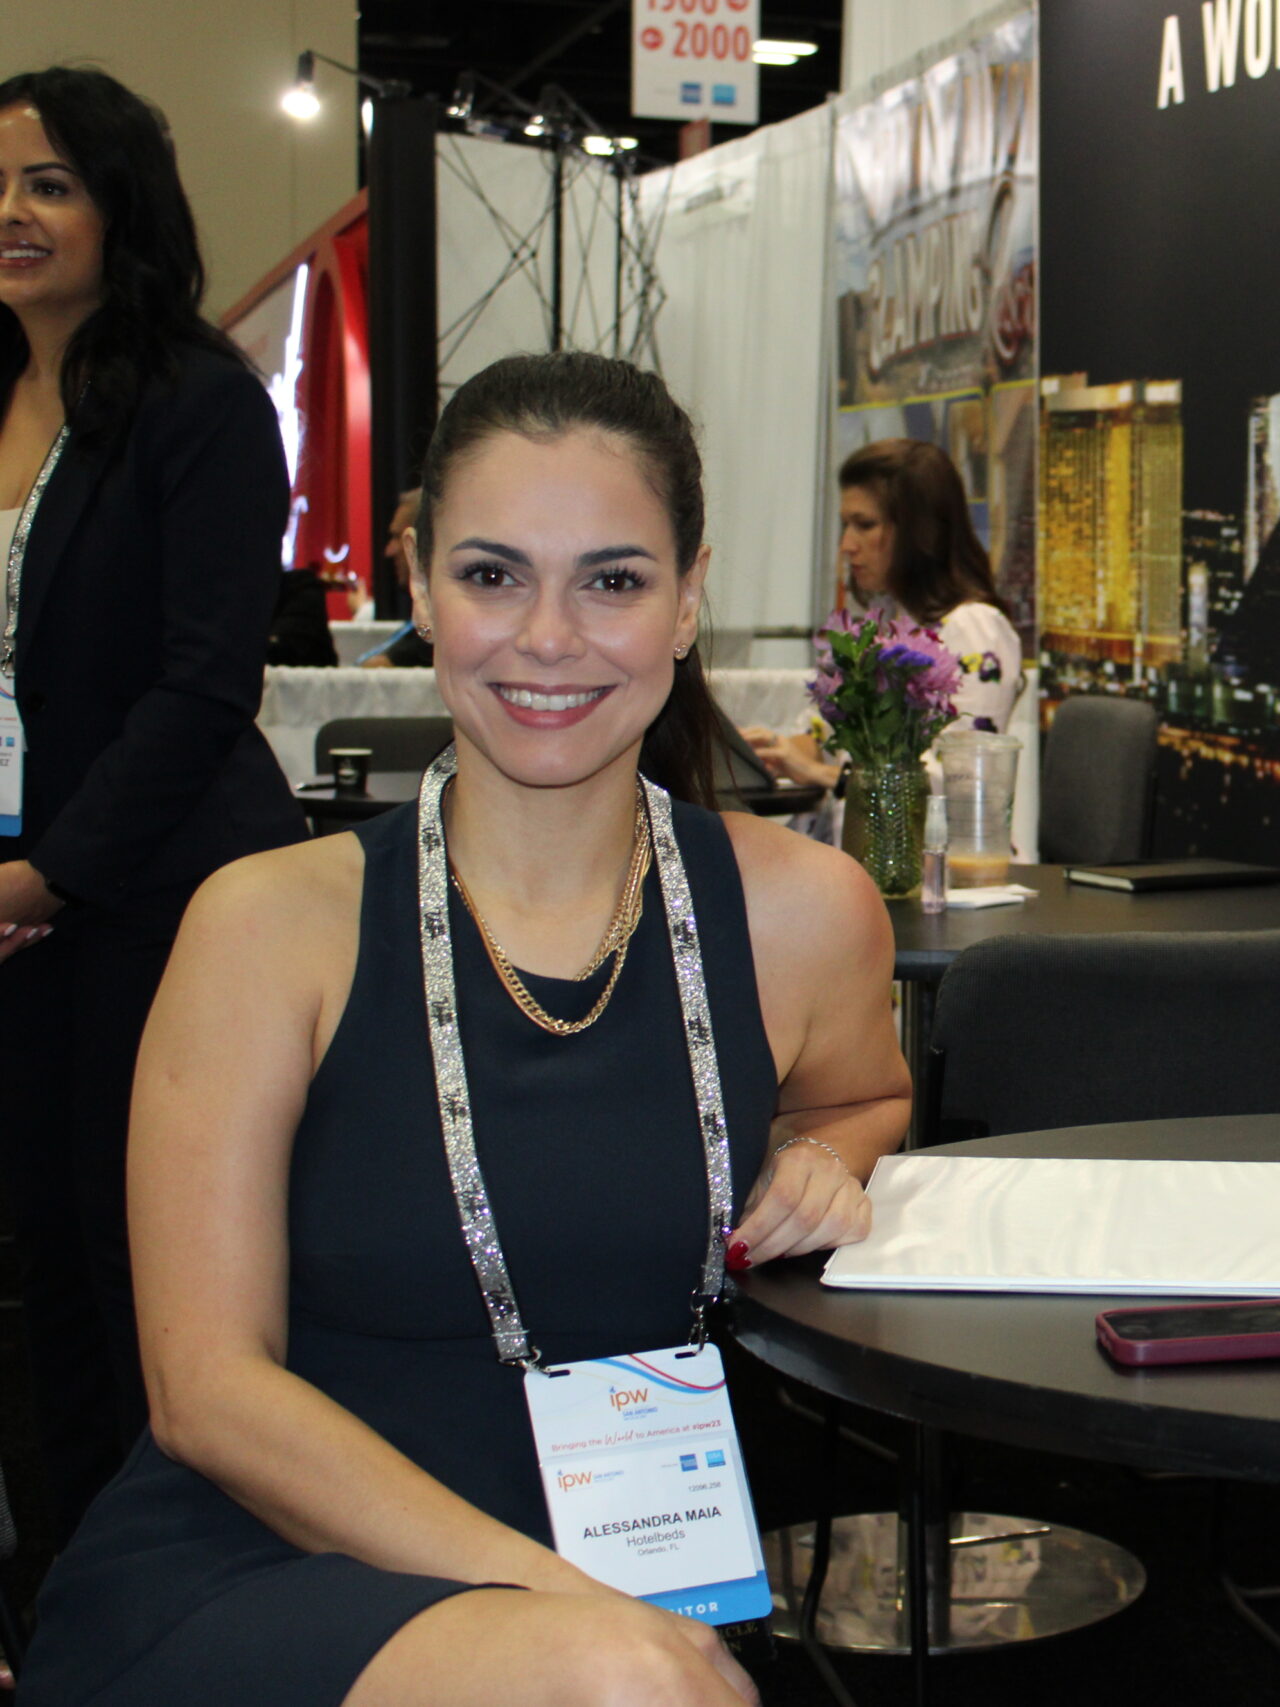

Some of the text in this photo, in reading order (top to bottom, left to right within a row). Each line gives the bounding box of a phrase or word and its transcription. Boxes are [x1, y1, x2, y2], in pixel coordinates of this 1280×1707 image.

[672, 19, 751, 62] 2000
[1157, 15, 1185, 109] A
[609, 1387, 649, 1412] ipw
[552, 1441, 588, 1452] Bringing
[589, 1438, 602, 1447] the
[604, 1430, 634, 1446] World
[635, 1431, 645, 1439] to
[646, 1426, 681, 1438] America
[557, 1470, 593, 1493] ipw
[583, 1506, 722, 1539] ALESSANDRA MAIA
[627, 1529, 686, 1547] Hotelbeds
